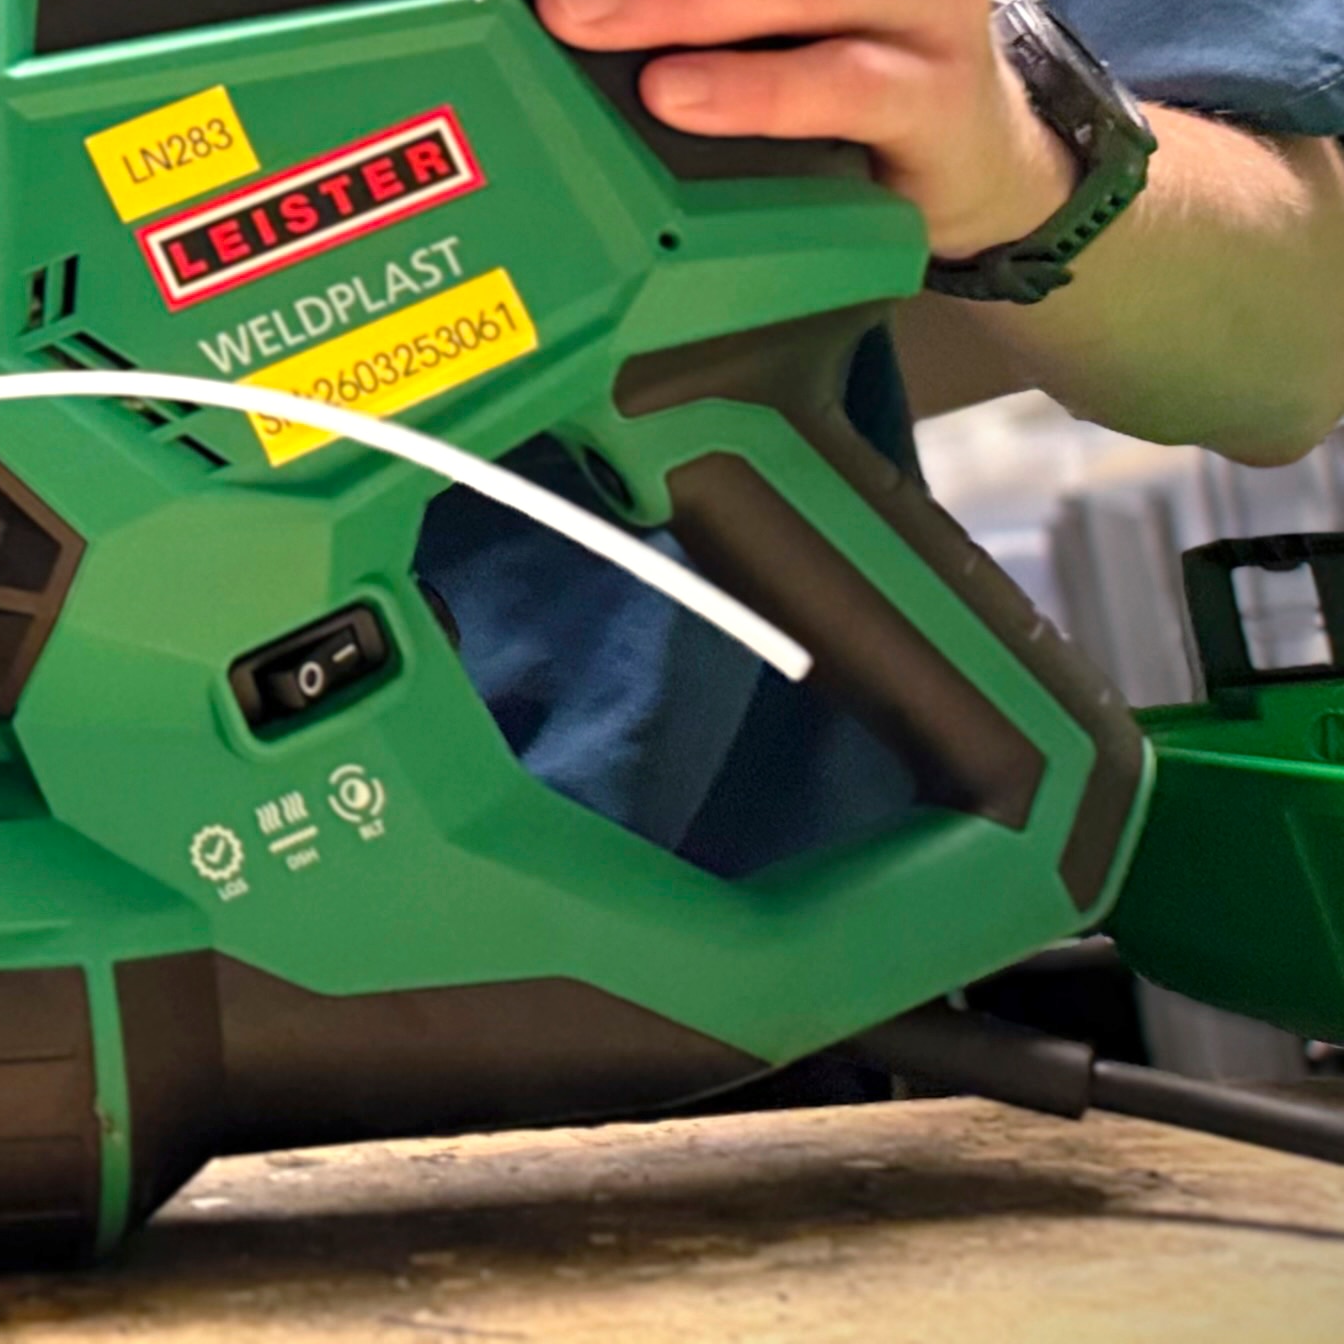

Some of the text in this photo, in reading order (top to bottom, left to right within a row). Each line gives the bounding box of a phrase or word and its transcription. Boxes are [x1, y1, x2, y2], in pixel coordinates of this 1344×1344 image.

[122, 117, 234, 186] LN283
[167, 139, 455, 280] LEISTER
[198, 235, 465, 375] WELDPLAST
